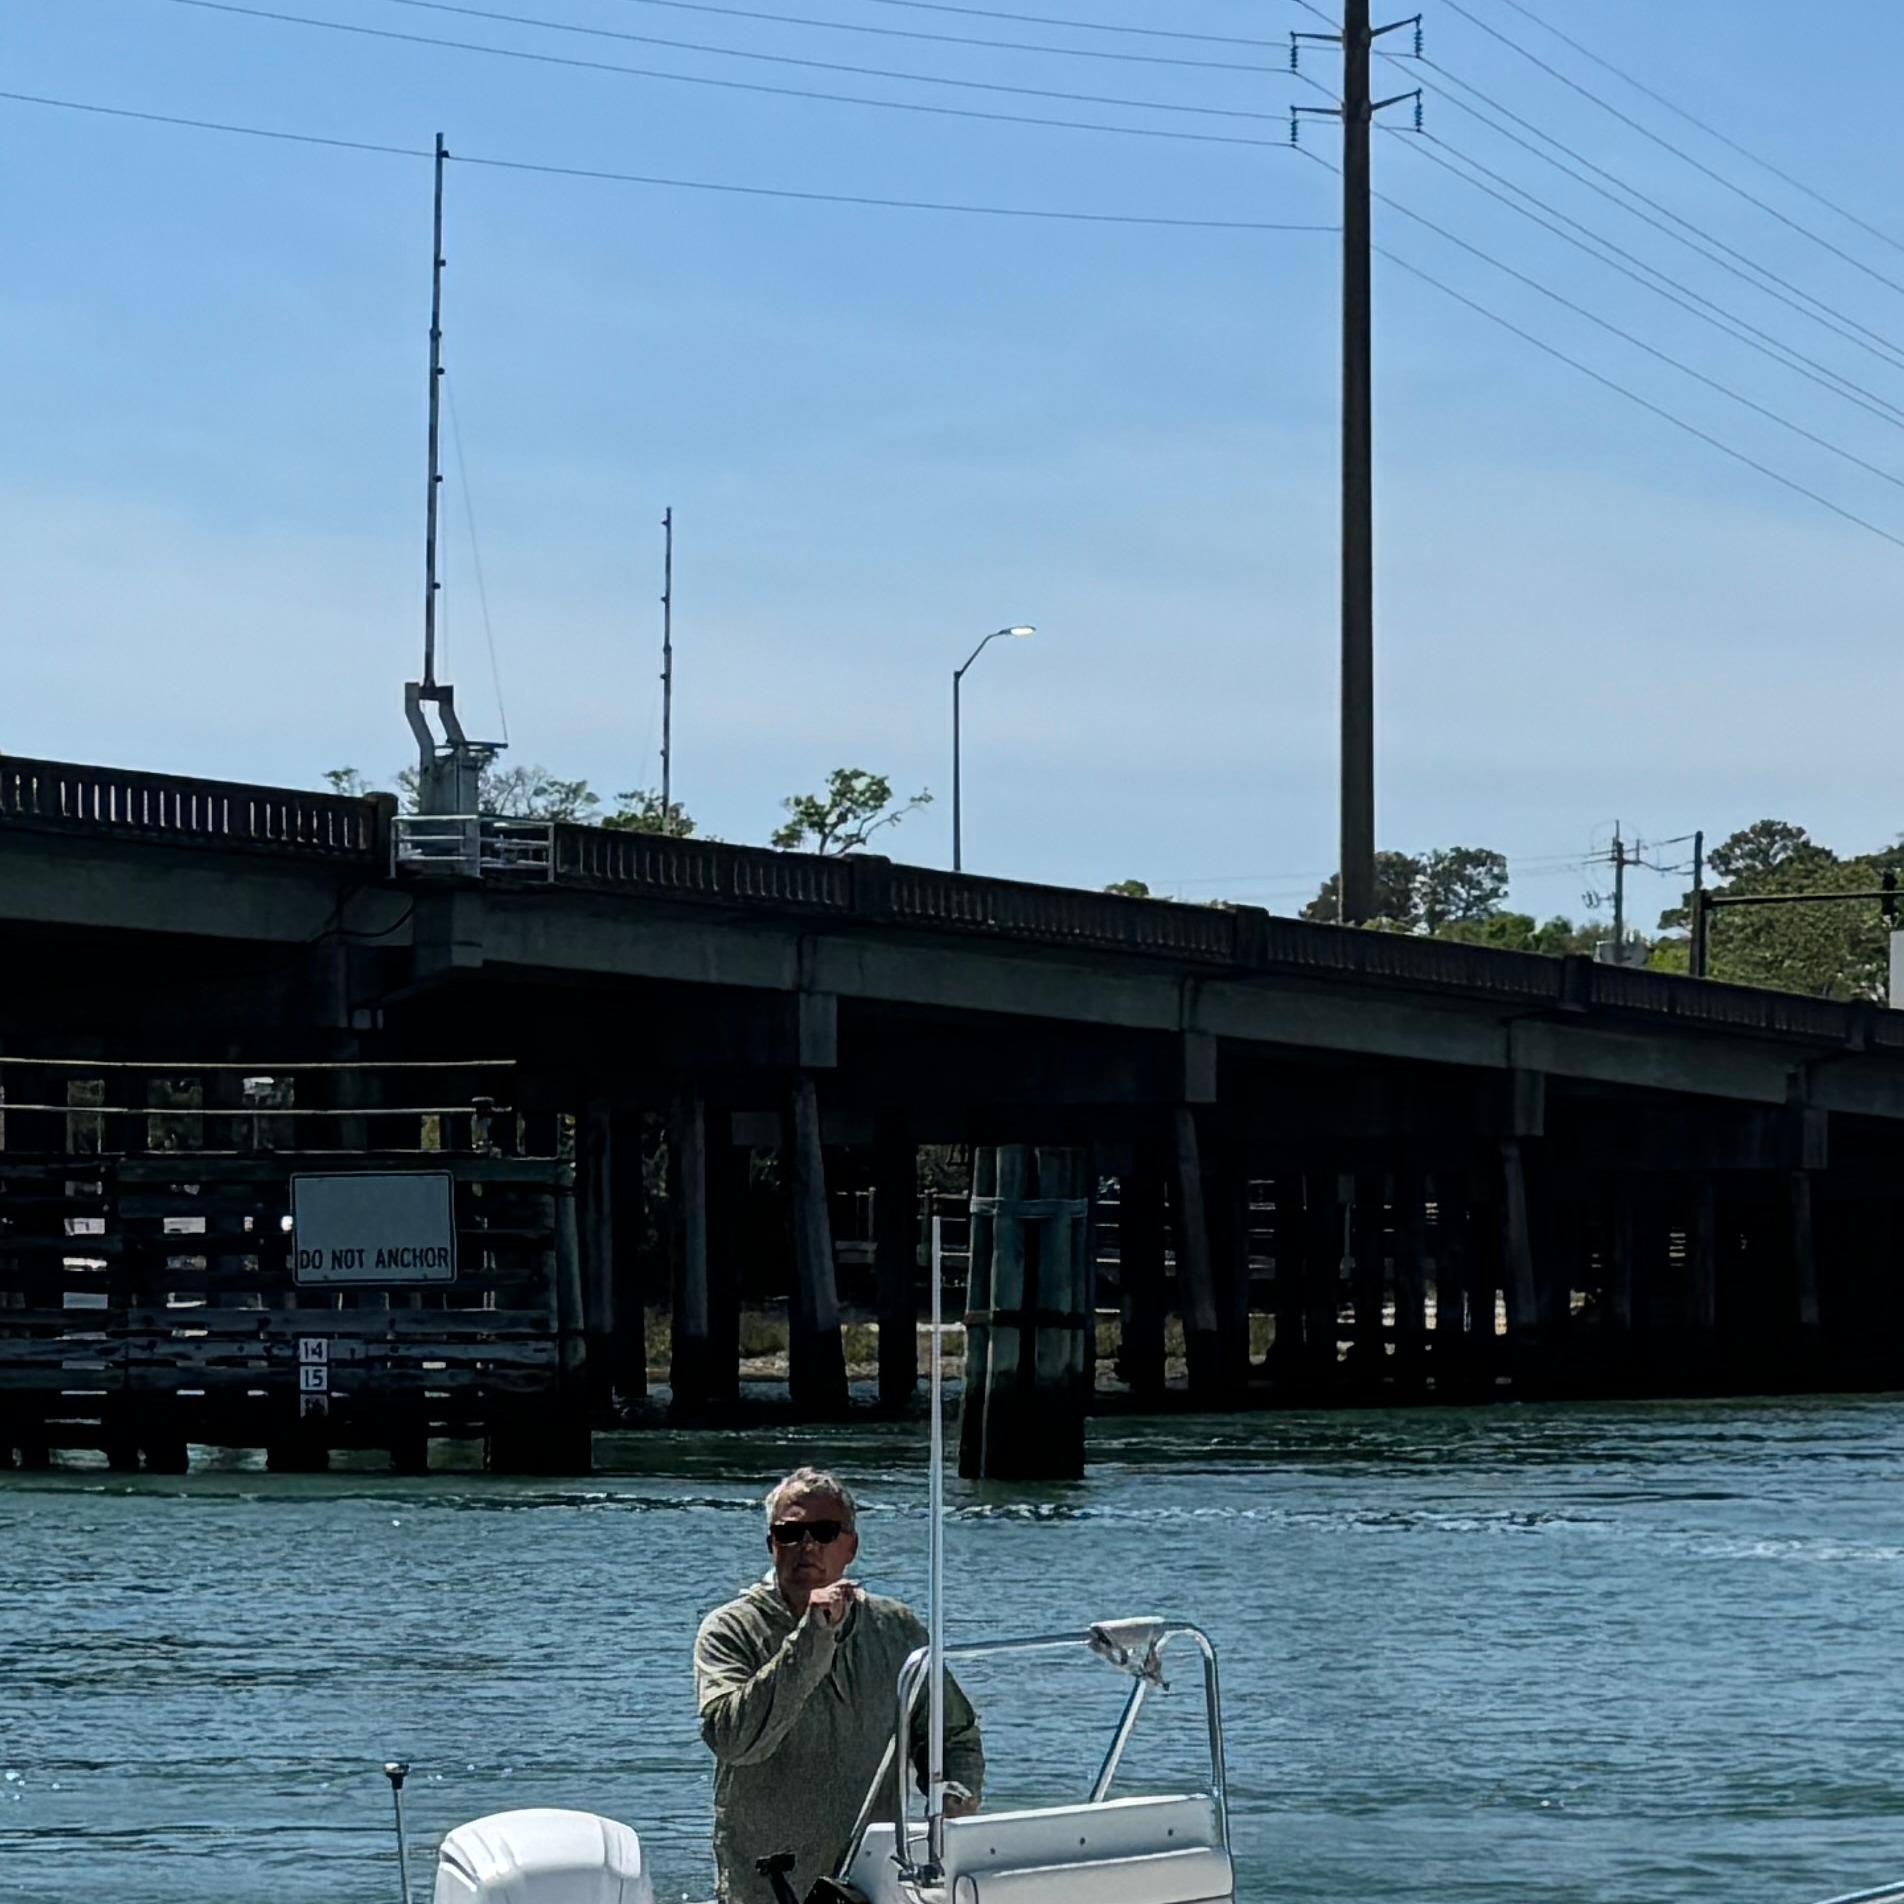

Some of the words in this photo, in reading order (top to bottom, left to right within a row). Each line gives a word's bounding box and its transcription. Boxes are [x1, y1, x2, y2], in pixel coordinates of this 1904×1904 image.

[300, 1249, 323, 1269] DO
[331, 1248, 365, 1270] NOT
[375, 1247, 449, 1268] ANCHOR
[304, 1341, 322, 1359] 14
[305, 1369, 323, 1387] 15
